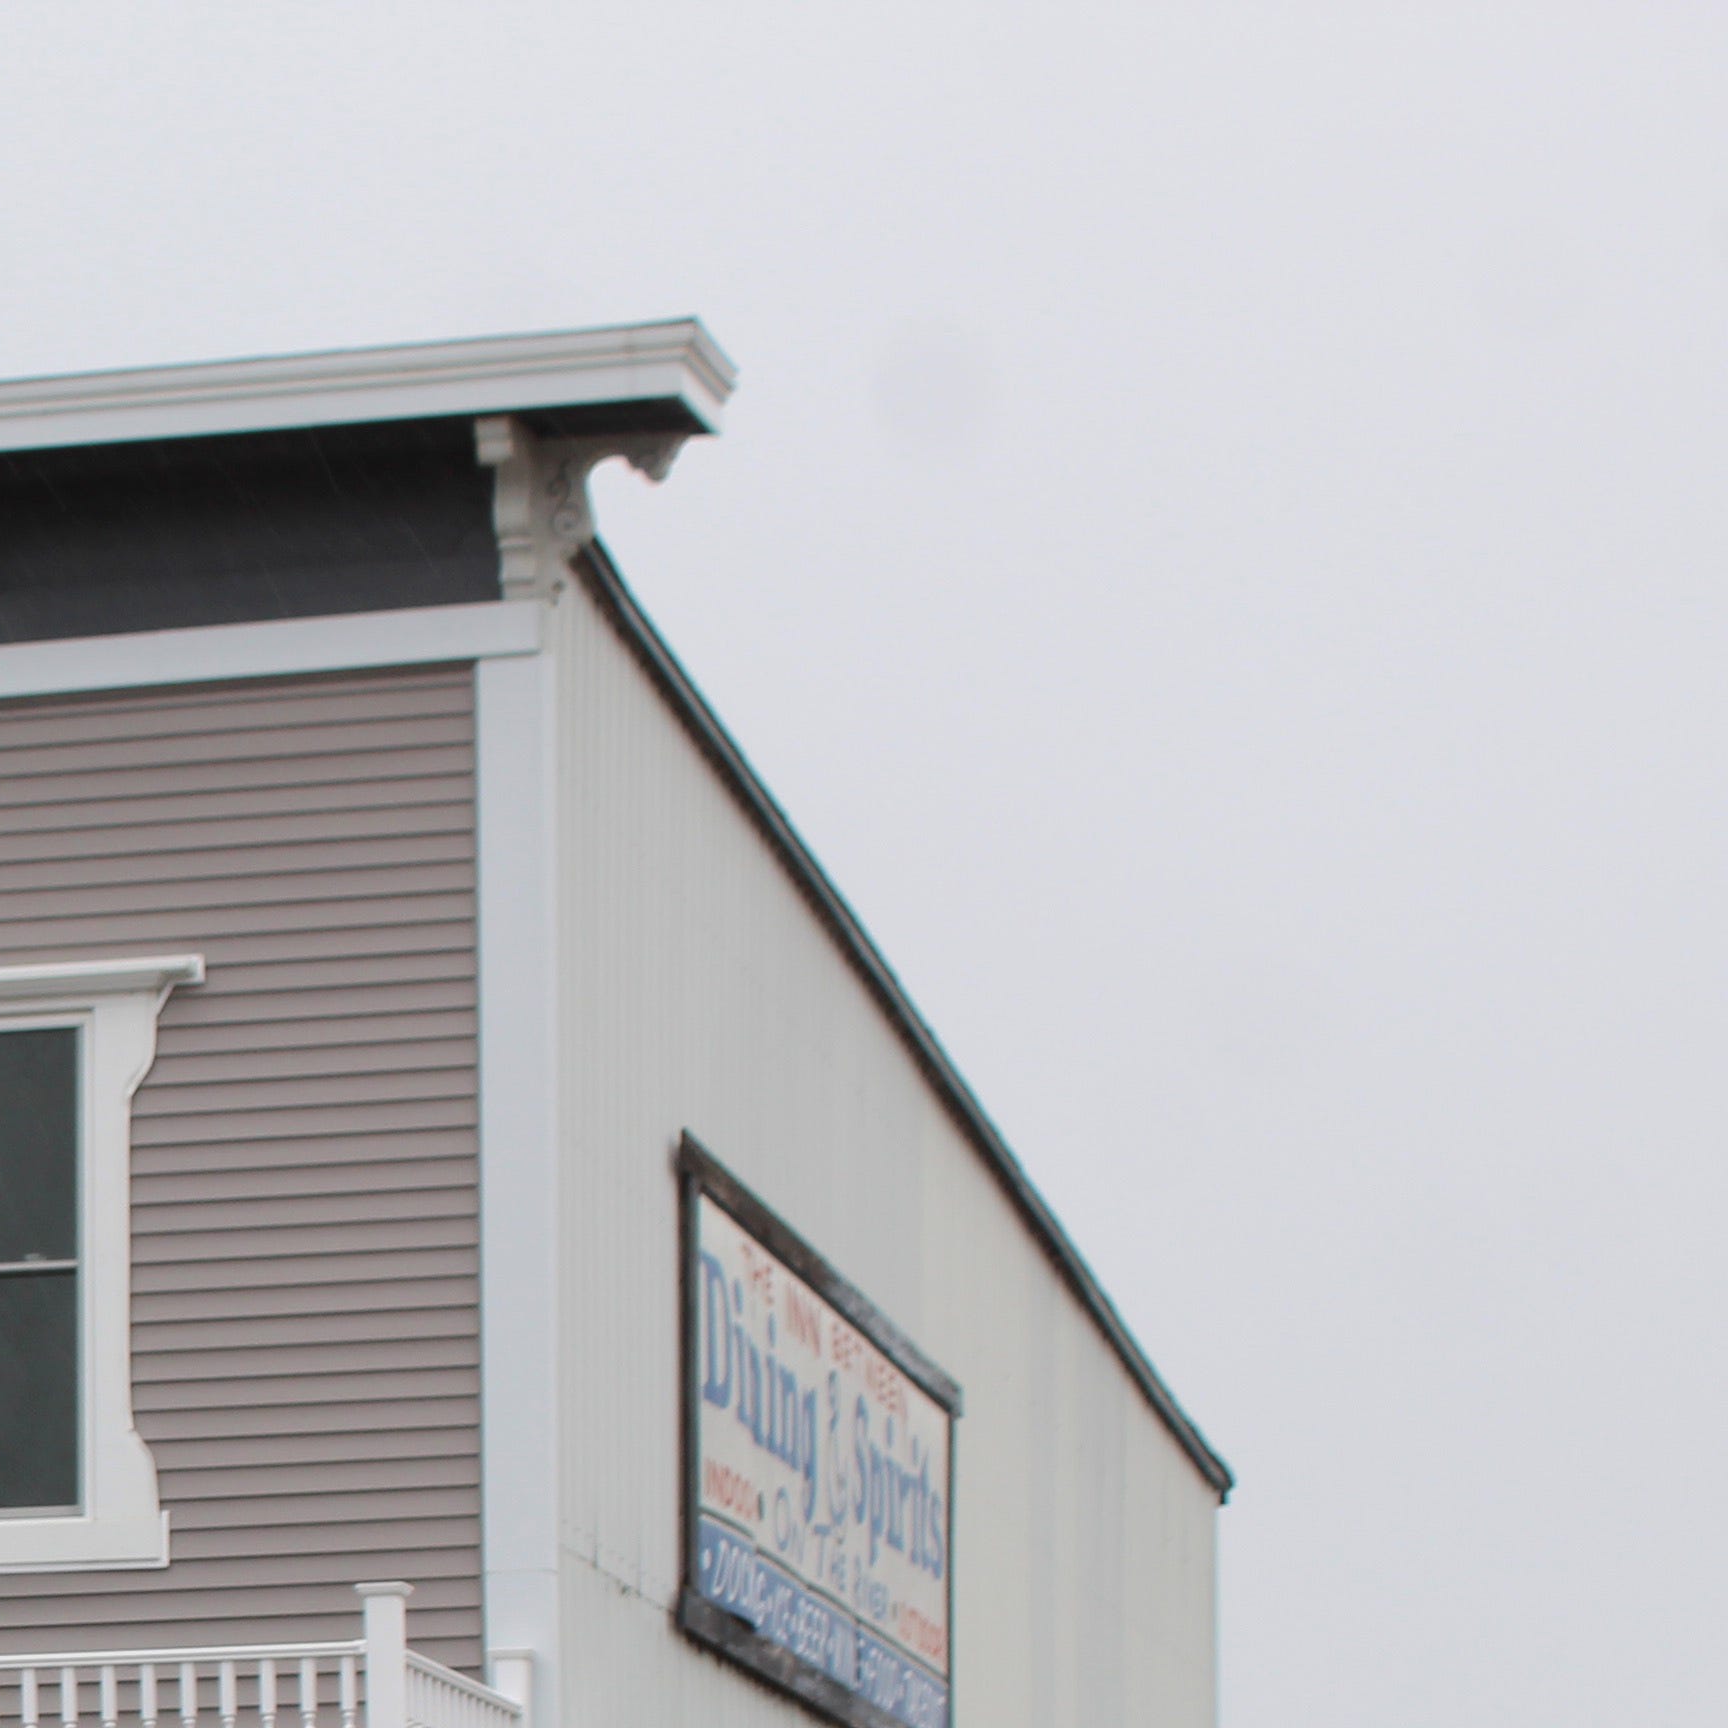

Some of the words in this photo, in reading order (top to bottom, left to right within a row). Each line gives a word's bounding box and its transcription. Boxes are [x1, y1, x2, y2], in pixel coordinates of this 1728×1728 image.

[700, 1250, 817, 1522] Dining
[855, 1393, 944, 1580] Spirits
[785, 1282, 820, 1358] INN
